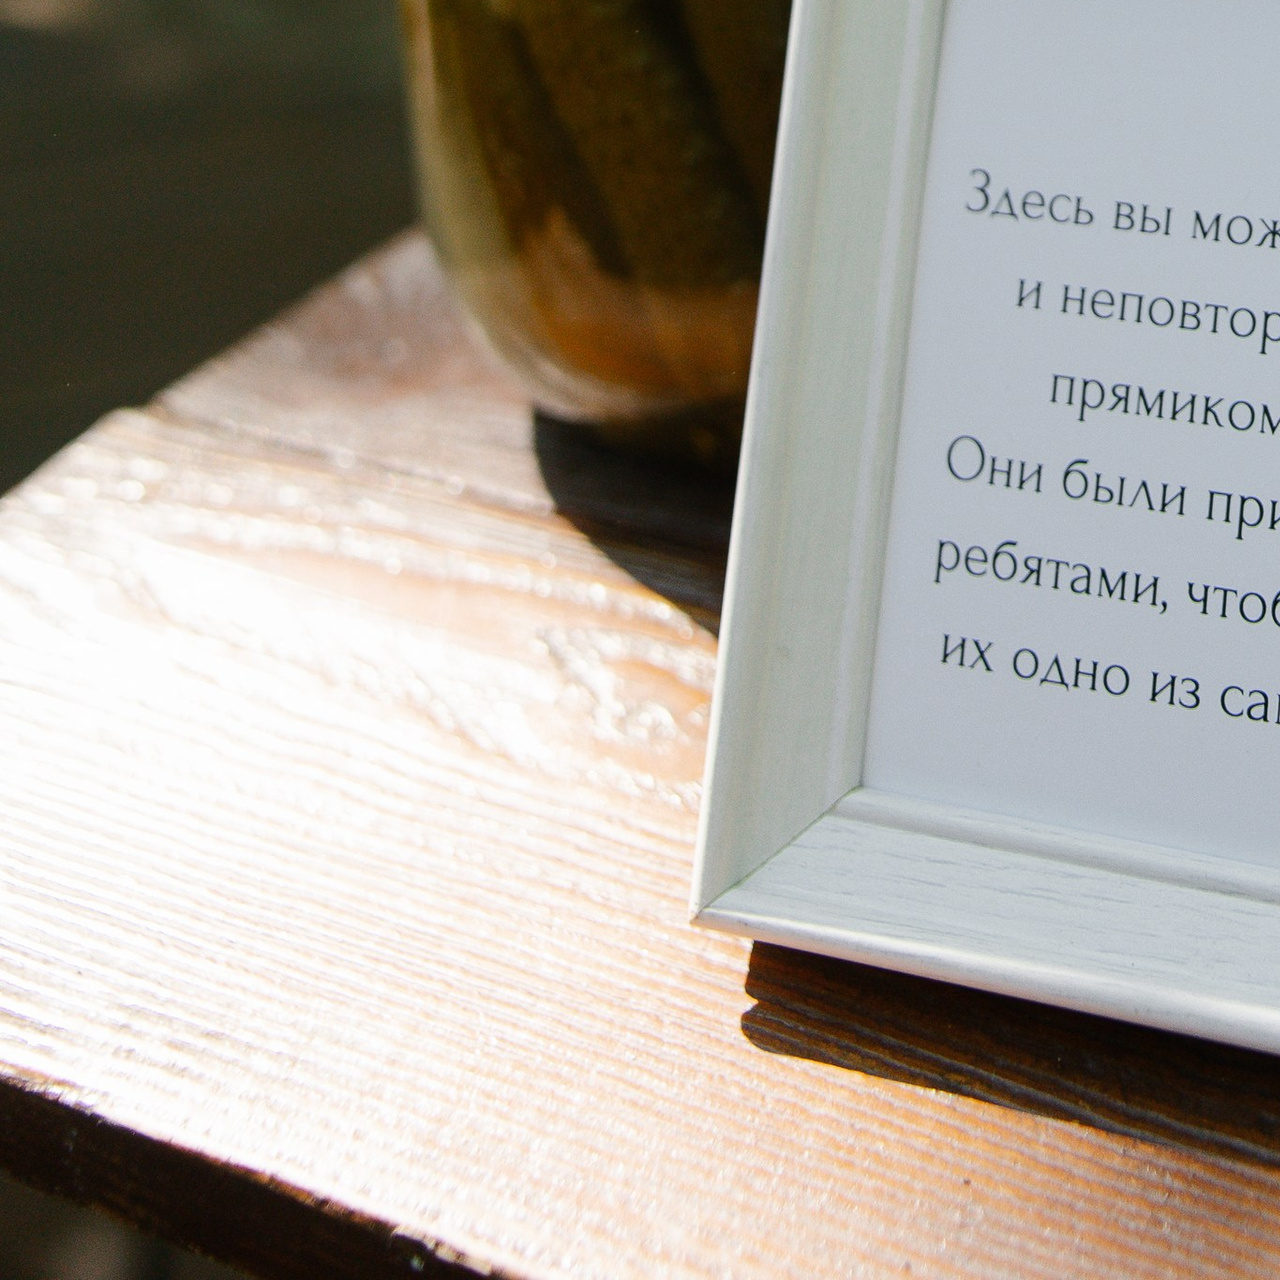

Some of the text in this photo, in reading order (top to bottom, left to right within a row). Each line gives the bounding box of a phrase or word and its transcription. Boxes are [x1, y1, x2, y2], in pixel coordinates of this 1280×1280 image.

[966, 169, 1094, 225] Здесь
[1113, 201, 1172, 236] вы
[1016, 279, 1042, 310] и
[947, 435, 1043, 493] Они
[1063, 459, 1186, 516] были
[934, 540, 1167, 614] ребятами,
[941, 634, 993, 672] их
[1013, 648, 1130, 695] одно
[1149, 671, 1200, 709] из
